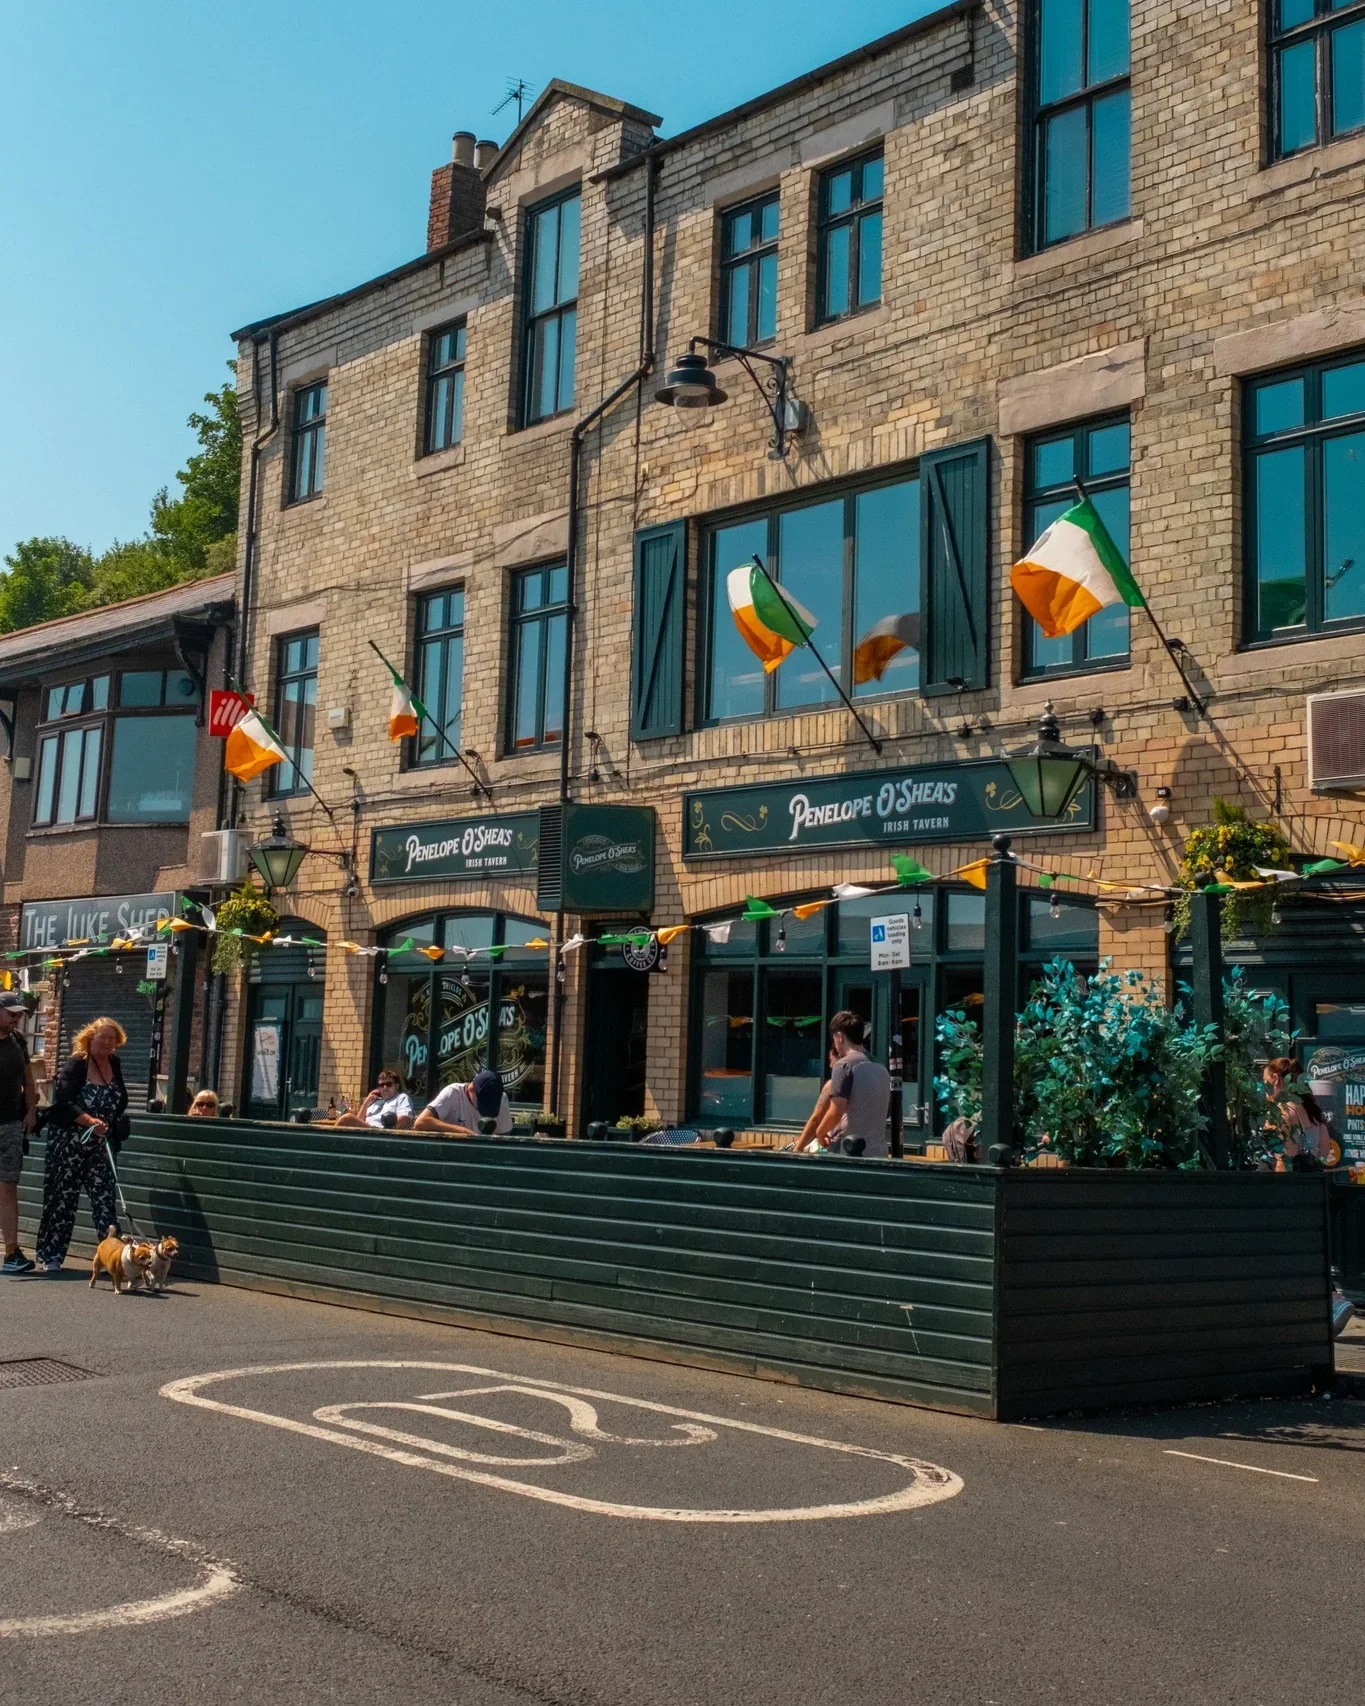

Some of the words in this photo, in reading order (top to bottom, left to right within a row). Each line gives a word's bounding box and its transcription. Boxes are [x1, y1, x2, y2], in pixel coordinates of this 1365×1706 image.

[788, 793, 873, 840] PENELOPE
[876, 778, 958, 818] O'SHEA'S
[883, 820, 909, 833] IRISH
[912, 816, 949, 831] TAVERN
[405, 835, 460, 872] PENELOPE
[462, 825, 513, 855] O'SHEA'S
[465, 858, 483, 868] IRISH
[484, 856, 508, 866] TAVERN
[573, 853, 607, 870] PENELOPE
[607, 846, 637, 859] O'SHEA'S
[25, 909, 58, 947] THE
